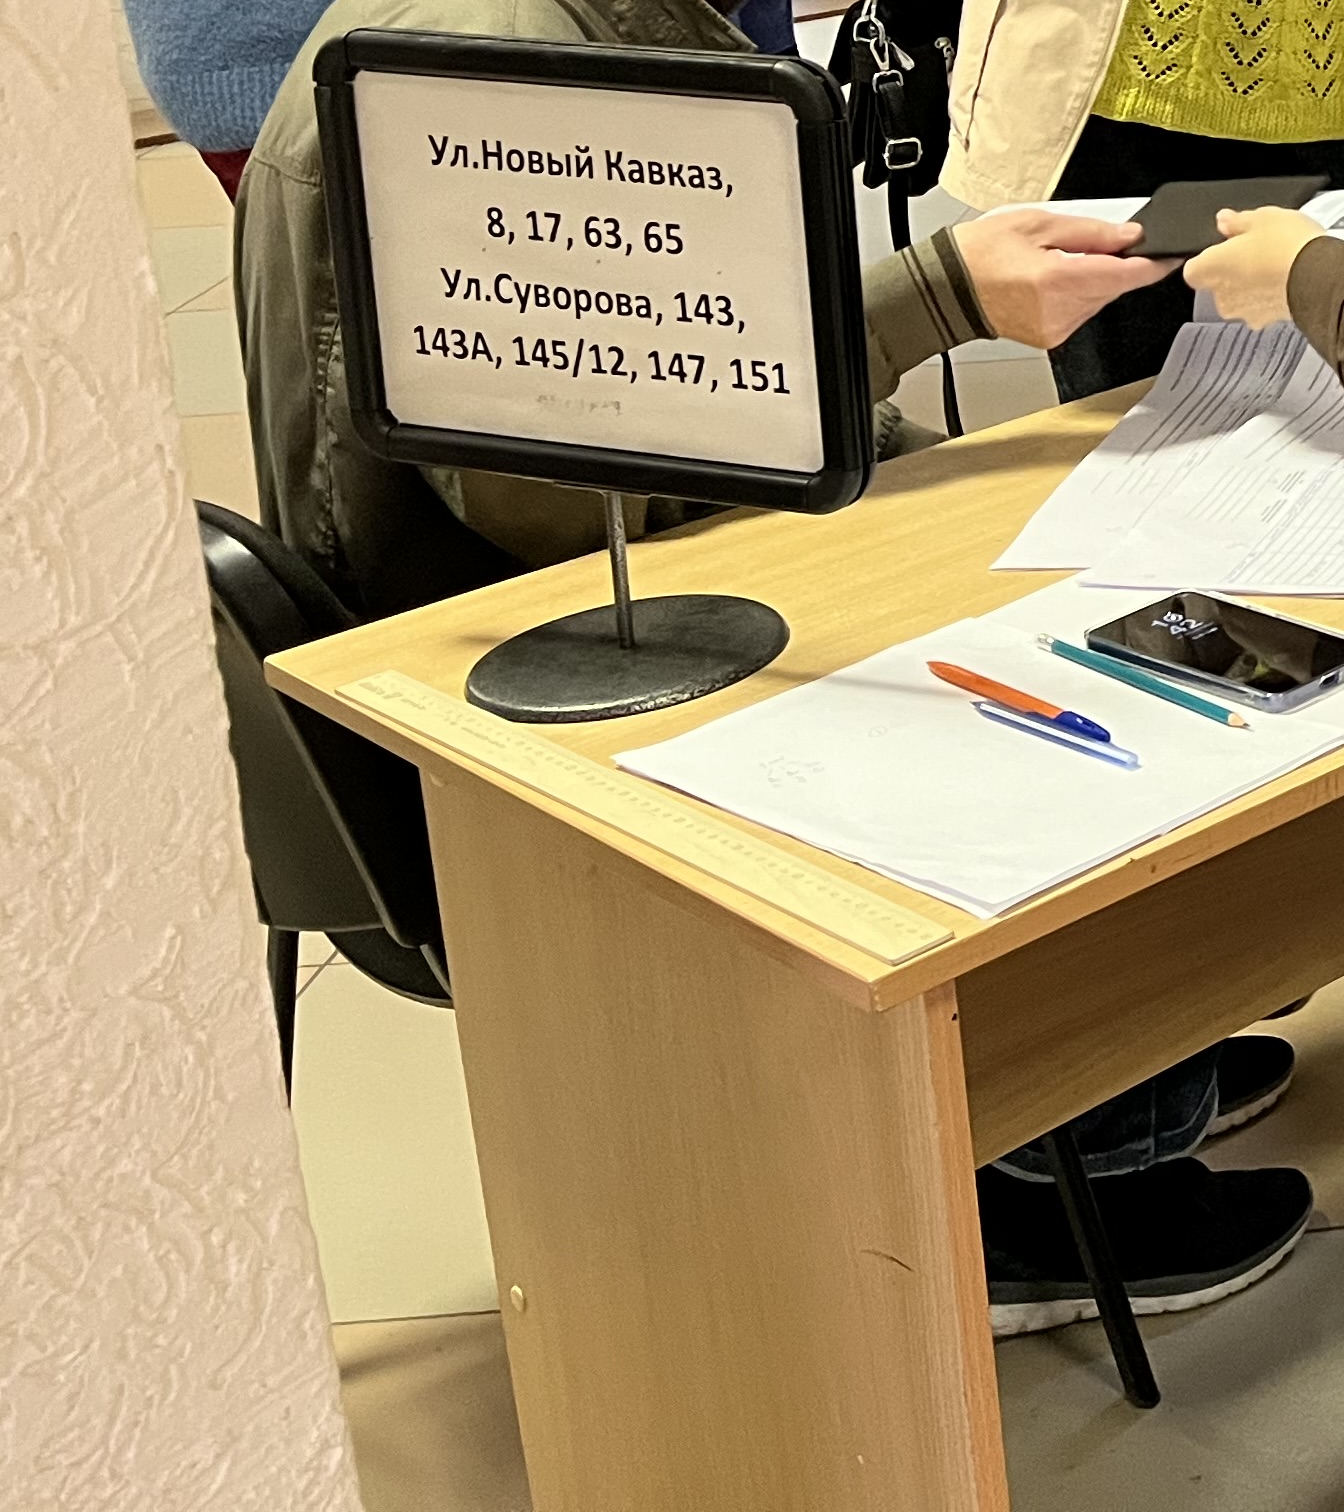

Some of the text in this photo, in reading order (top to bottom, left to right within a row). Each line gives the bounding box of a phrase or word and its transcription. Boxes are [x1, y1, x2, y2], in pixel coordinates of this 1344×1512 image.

[427, 133, 735, 198] Ул.Новый Кавказ,
[486, 206, 685, 257] 8, 17, 63, 65
[440, 267, 746, 334] Ул.Суворова, 143,
[413, 325, 792, 395] 143А, 145/12, 147, 151
